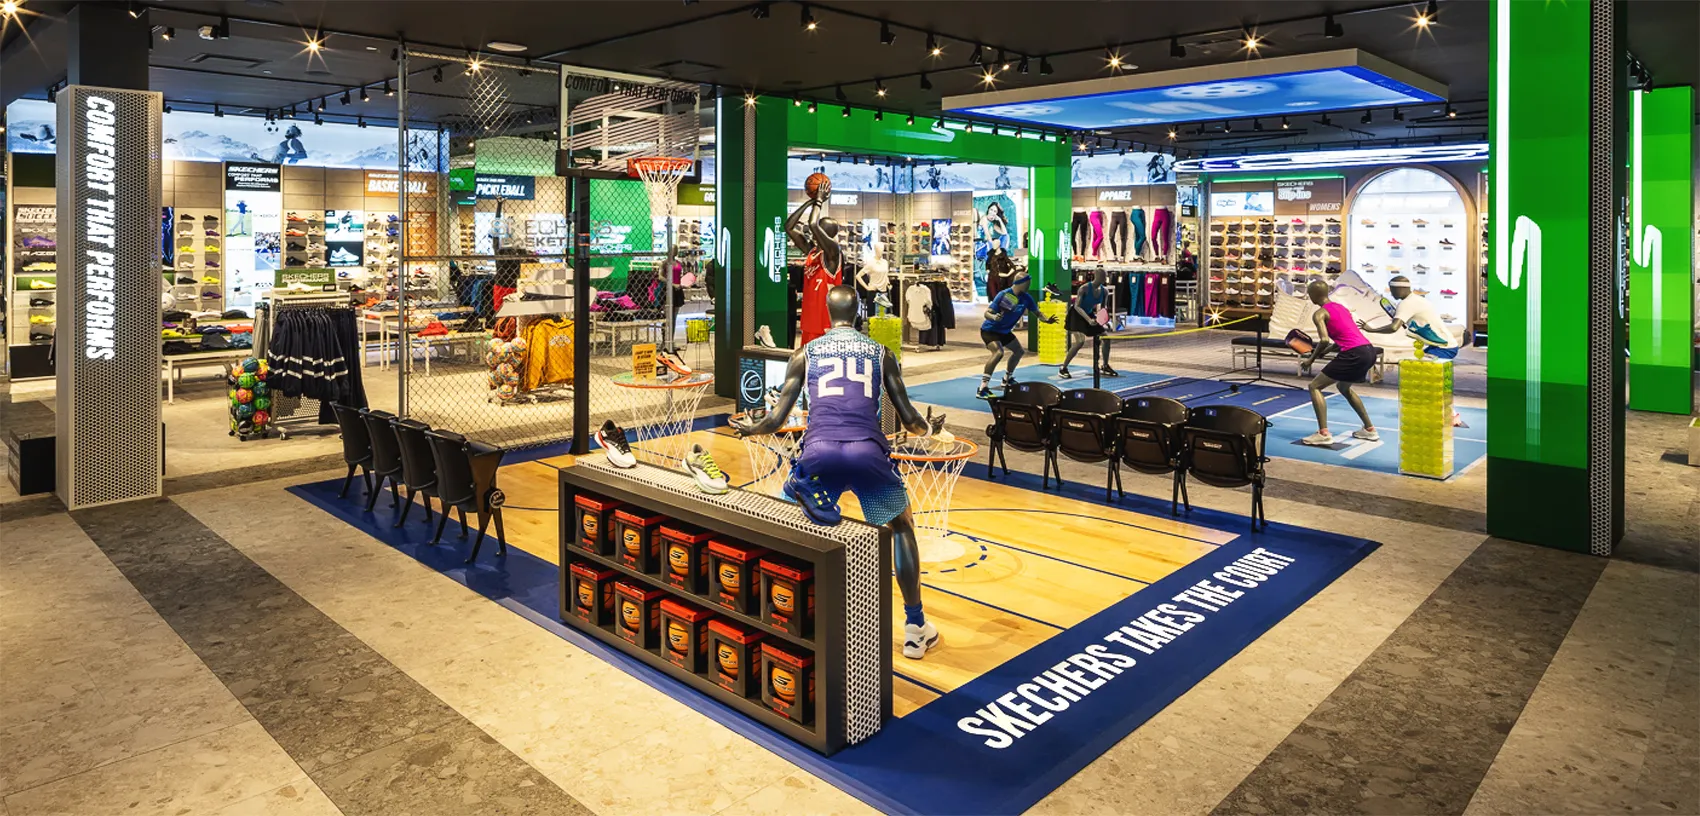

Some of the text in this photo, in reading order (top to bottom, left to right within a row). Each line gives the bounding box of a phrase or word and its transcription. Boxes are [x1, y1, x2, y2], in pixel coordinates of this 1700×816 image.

[564, 74, 698, 106] COMFOT THAT PERFORMS
[227, 166, 279, 174] SKECHERS
[476, 184, 525, 196] PICKLEBALL
[1099, 190, 1132, 201] APPAREL
[1309, 202, 1341, 211] WOMENS
[86, 95, 115, 361] COMFORT THAT PERFORMS
[814, 279, 823, 291] 7
[813, 341, 876, 355] SKECHERS
[817, 357, 873, 399] 24
[957, 547, 1296, 749] SKECHERS TAKES THE COURT
